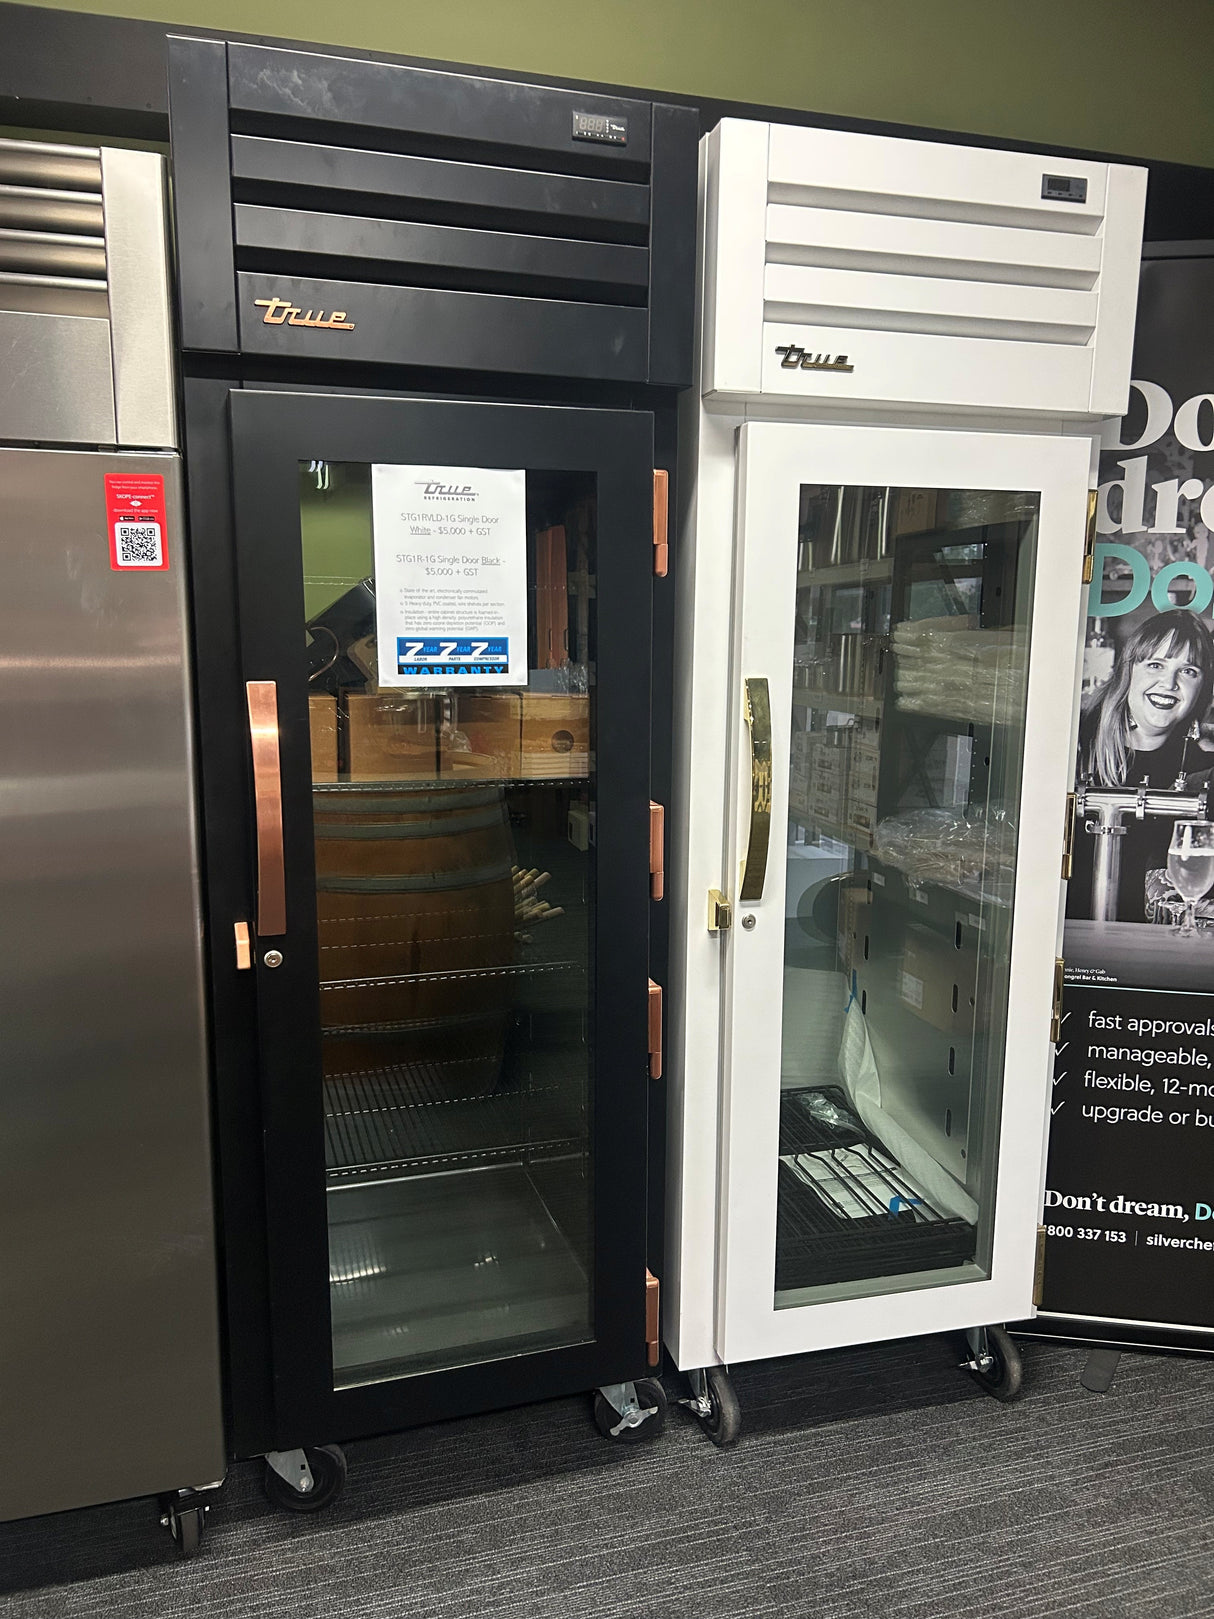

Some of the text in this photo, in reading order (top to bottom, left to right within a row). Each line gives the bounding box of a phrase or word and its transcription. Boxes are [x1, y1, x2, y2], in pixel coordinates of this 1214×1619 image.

[457, 514, 480, 525] Single
[481, 515, 500, 524] Door
[410, 525, 431, 535] White
[476, 527, 491, 536] GST
[396, 554, 436, 564] STG1R-1G
[437, 555, 460, 566] Single
[461, 556, 480, 564] Door
[481, 556, 501, 566] Black
[463, 568, 479, 576] GST
[405, 642, 424, 656] 7
[439, 642, 458, 656] 7
[471, 642, 489, 656] 7
[403, 666, 504, 674] WARRANTY
[1088, 1010, 1123, 1030] fast
[1088, 1045, 1212, 1070] manageable,
[1084, 1070, 1155, 1096] flexible,
[1082, 1104, 1164, 1124] upgrade
[1169, 1111, 1190, 1125] or
[1044, 1189, 1214, 1223] Don't dream, D
[1044, 1224, 1074, 1238] 800
[1077, 1227, 1101, 1241] 337
[1104, 1230, 1127, 1243] 153
